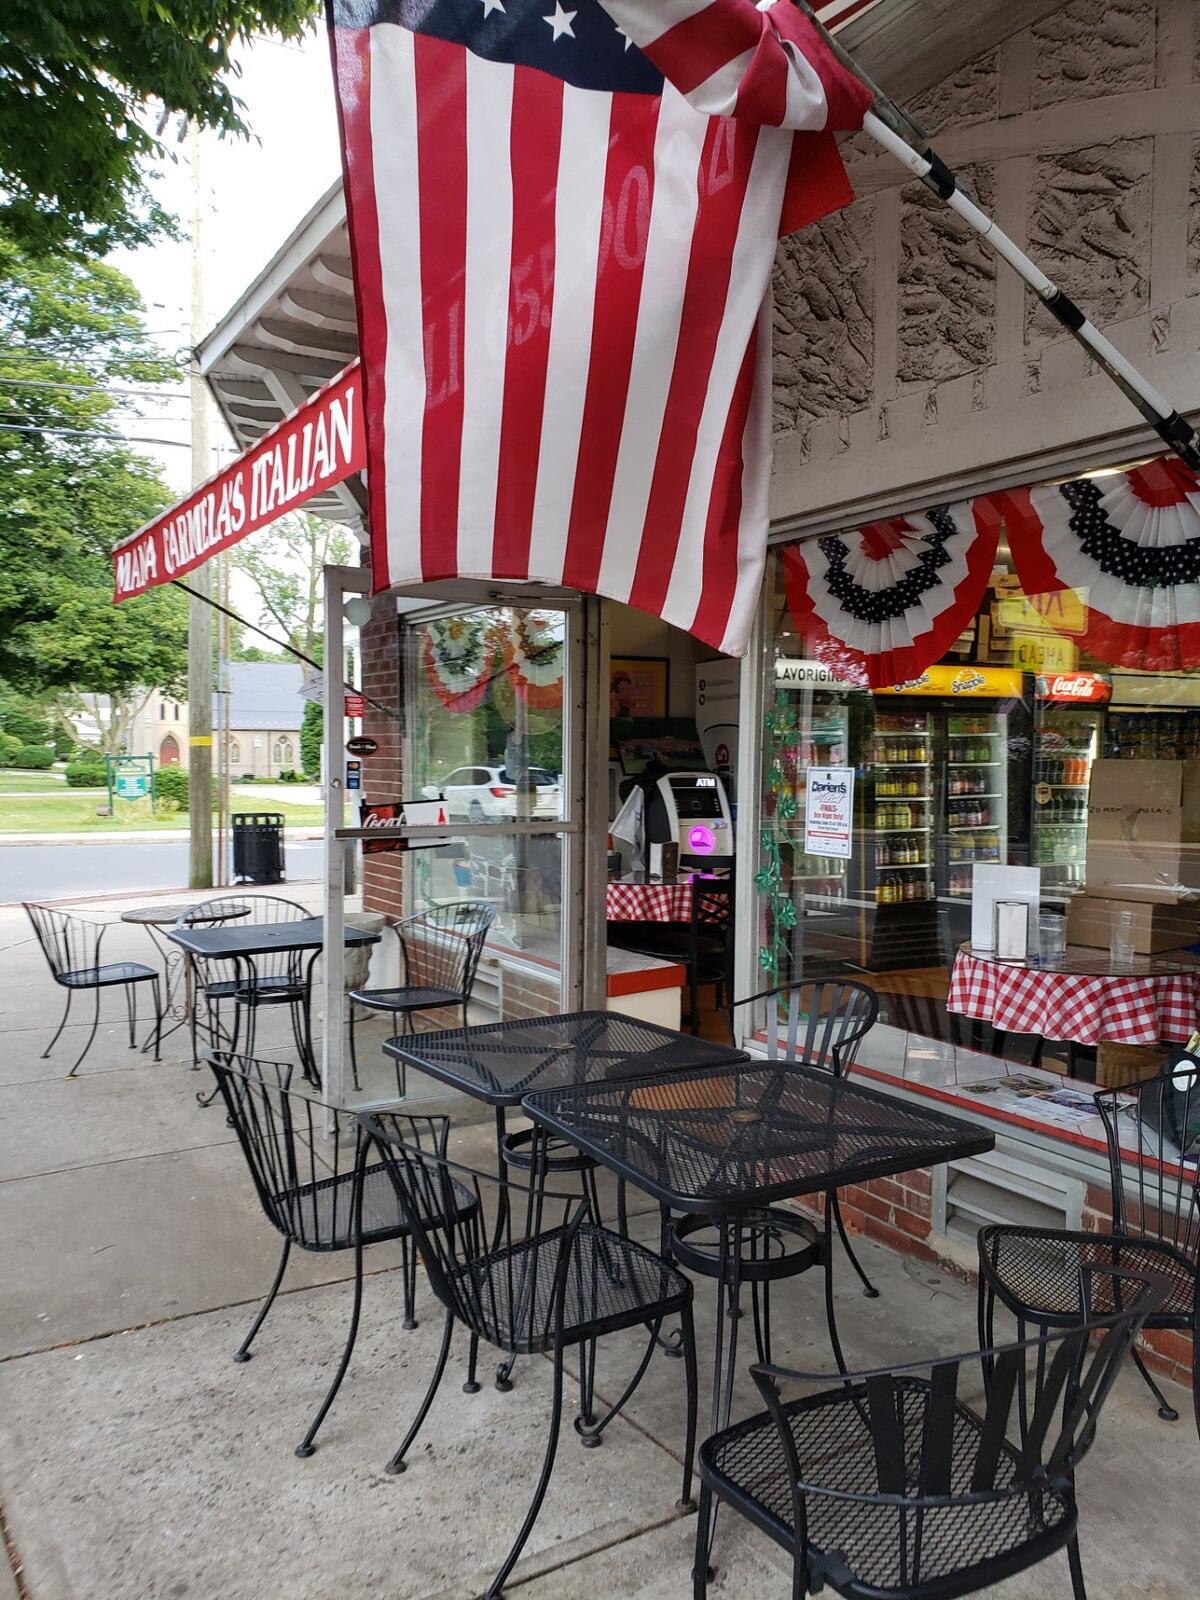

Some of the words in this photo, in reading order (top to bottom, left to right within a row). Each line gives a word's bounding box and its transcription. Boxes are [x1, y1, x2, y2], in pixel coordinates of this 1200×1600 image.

[250, 386, 354, 521] ITALIAN
[952, 673, 985, 693] Snapple
[696, 778, 715, 787] ATM
[812, 781, 847, 794] Darien's
